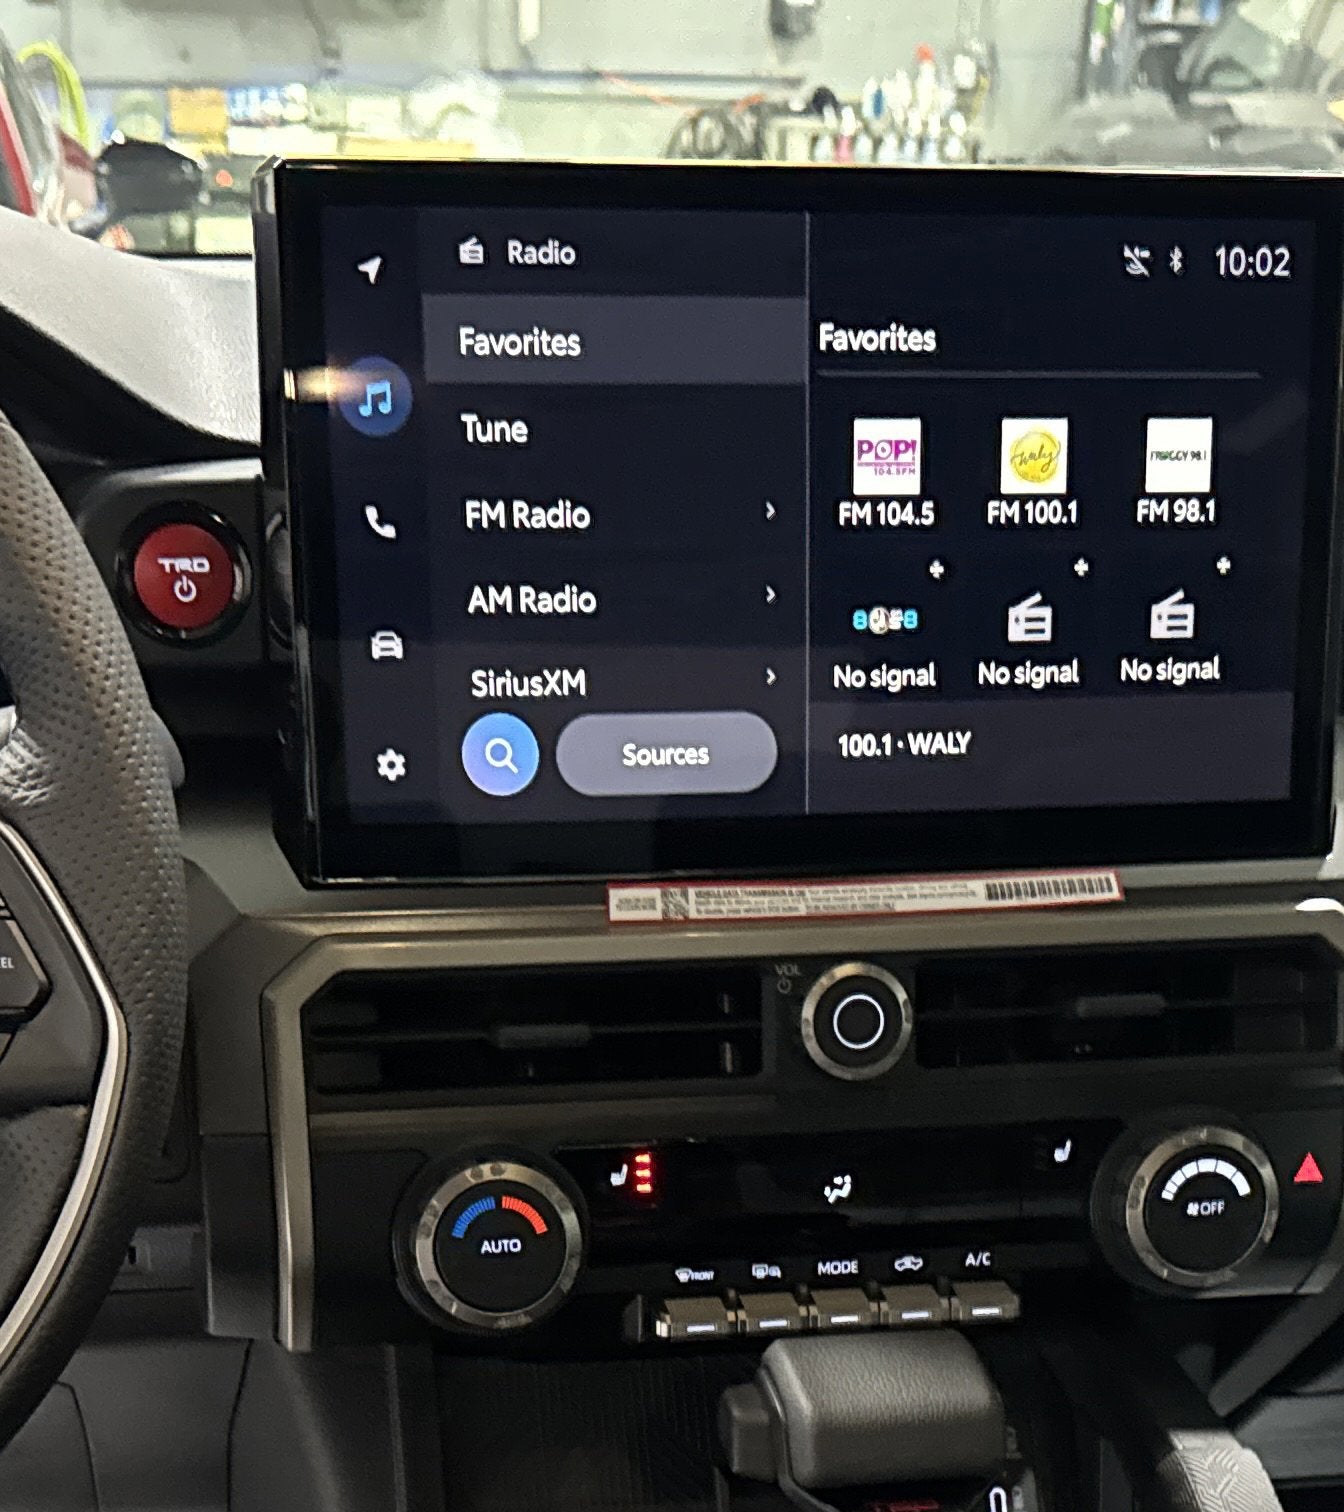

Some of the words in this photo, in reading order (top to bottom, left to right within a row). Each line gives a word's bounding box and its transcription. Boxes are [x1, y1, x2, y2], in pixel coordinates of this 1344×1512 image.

[507, 239, 577, 266] Radio
[1216, 246, 1291, 277] 10:02
[459, 326, 581, 357] Favorites
[819, 322, 937, 353] Favorites
[461, 413, 529, 444] Tune
[465, 500, 506, 529] FM
[513, 499, 591, 529] Radio
[839, 502, 872, 527] FM
[876, 501, 935, 526] 104.5
[987, 501, 1020, 525] FM
[1024, 500, 1078, 525] 100.1
[1136, 500, 1169, 524] FM
[1173, 498, 1216, 523] 98.1
[157, 557, 210, 573] TRD
[467, 586, 513, 614] AM
[519, 585, 597, 614] Radio
[471, 669, 587, 697] SiriusXM
[833, 664, 866, 689] No
[869, 662, 936, 693] signal
[978, 661, 1011, 685] No
[1014, 658, 1079, 689] signal
[1120, 658, 1152, 682] No
[1155, 655, 1220, 687] signal
[622, 743, 710, 767] Sources
[839, 733, 892, 757] 100.1
[907, 732, 972, 756] WALY
[1200, 1201, 1225, 1215] OFF
[481, 1238, 522, 1255] AUTO
[965, 1251, 991, 1267] A/C
[817, 1260, 859, 1276] MODE
